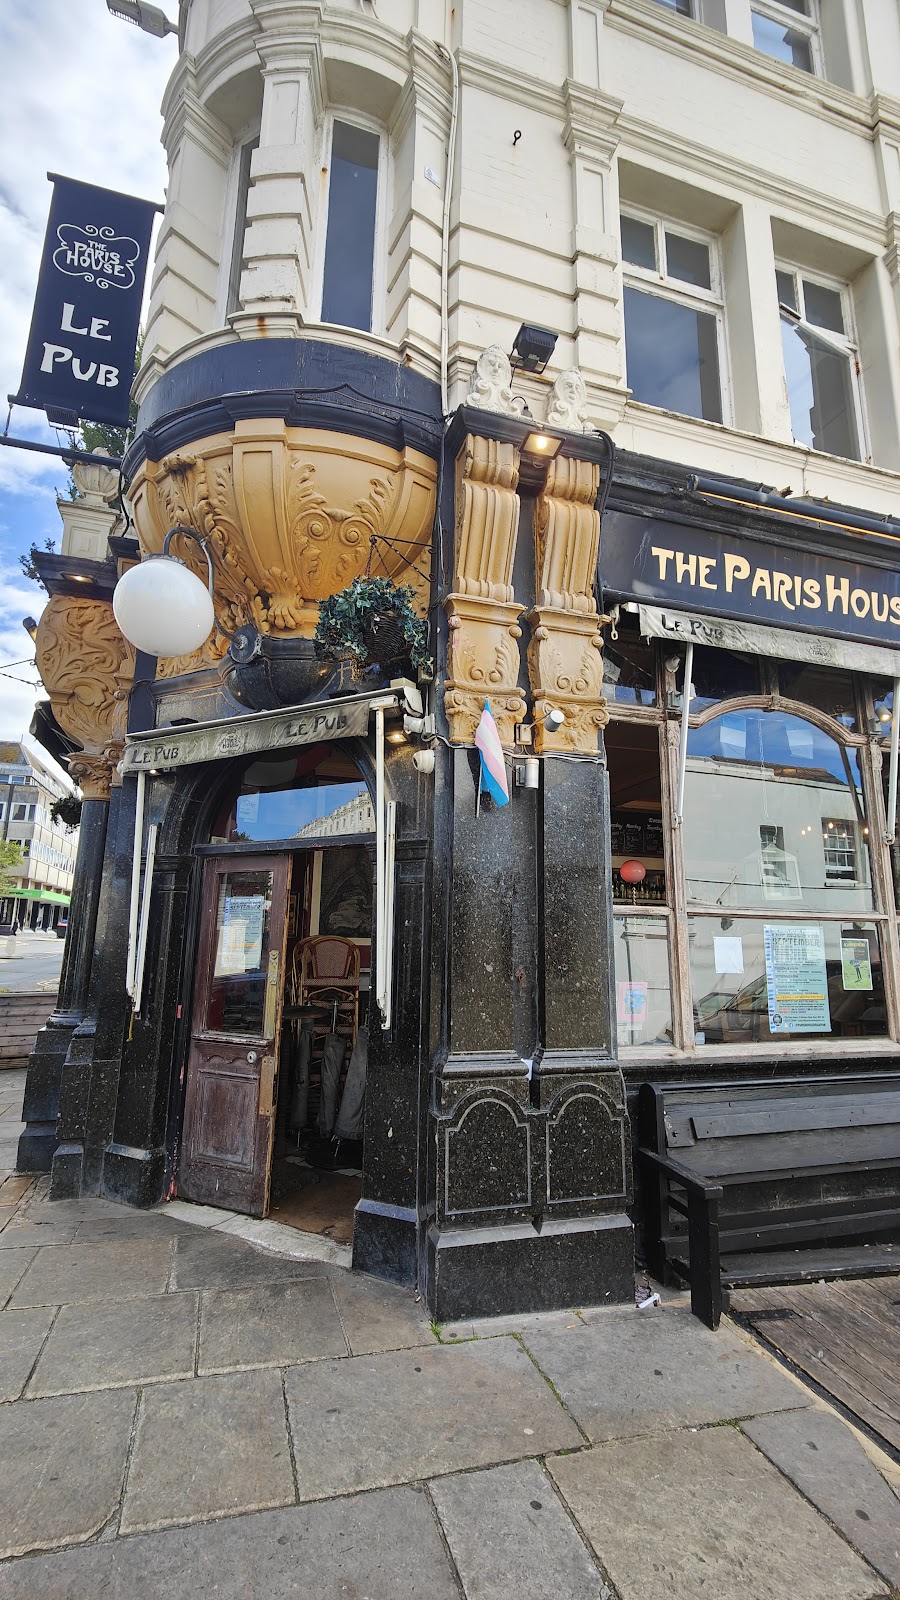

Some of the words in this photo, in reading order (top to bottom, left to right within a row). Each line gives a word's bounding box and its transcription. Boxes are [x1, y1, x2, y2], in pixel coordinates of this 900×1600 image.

[73, 241, 121, 265] PARIS
[88, 240, 107, 252] THE
[66, 250, 126, 277] HOUSE
[60, 302, 112, 341] LE
[40, 341, 119, 387] PUB
[651, 546, 718, 590] THE
[723, 553, 822, 610] PARIS
[661, 613, 684, 632] LE
[688, 618, 724, 640] PUB
[284, 721, 308, 738] LE
[311, 714, 348, 734] PUB
[130, 748, 151, 764] LE
[153, 744, 180, 762] PUB
[772, 937, 821, 947] SEPTEMBER
